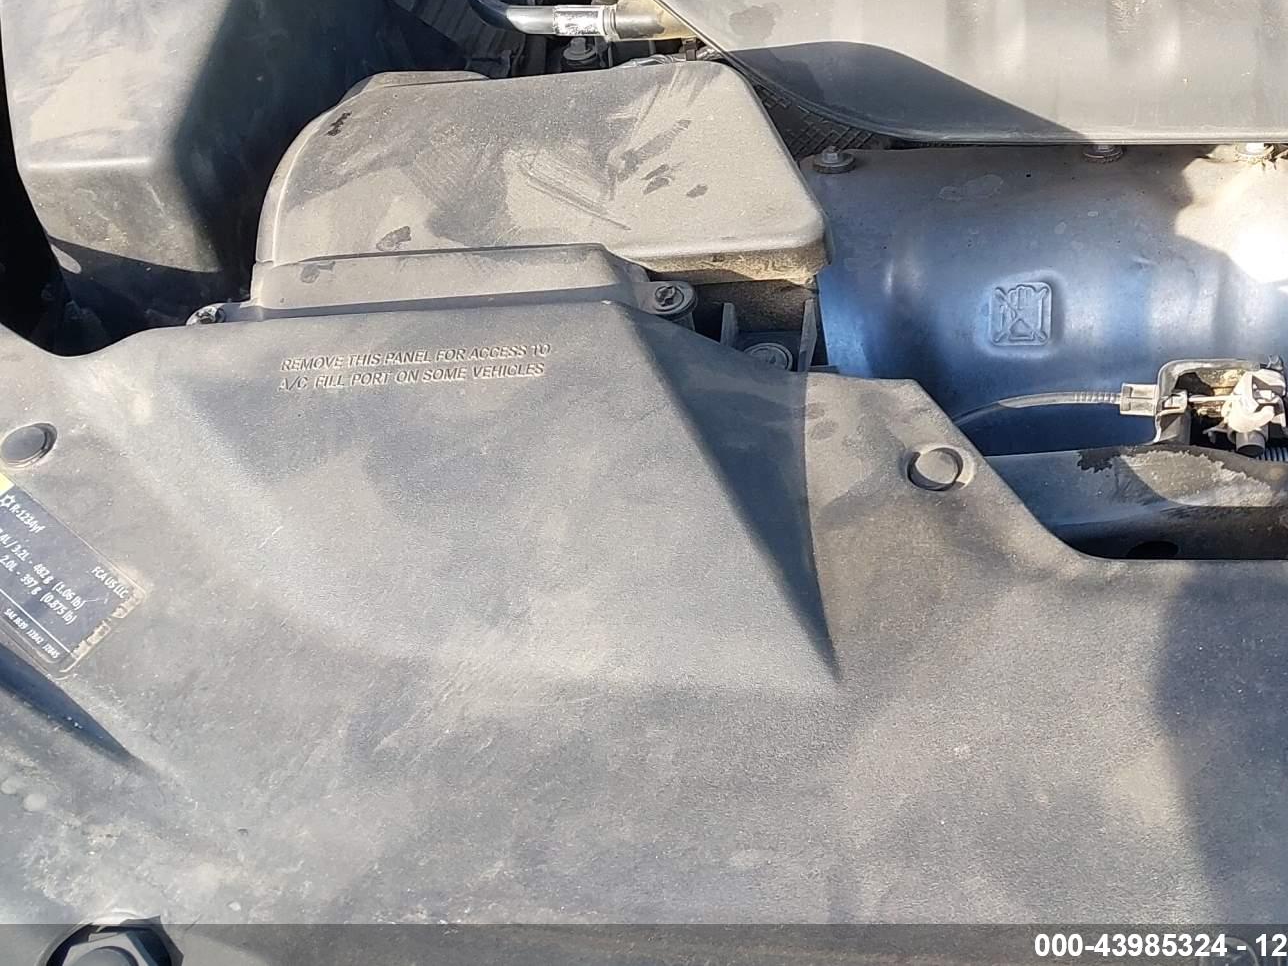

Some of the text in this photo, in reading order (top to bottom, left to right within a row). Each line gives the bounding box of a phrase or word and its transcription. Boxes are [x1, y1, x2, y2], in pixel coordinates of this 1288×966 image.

[281, 343, 551, 371] REMOVE THIS PANEL FOR ACCESS TO
[278, 362, 545, 391] A/C FILL PORT ON SOME VEHICLES
[91, 566, 129, 599] FCA US LLC
